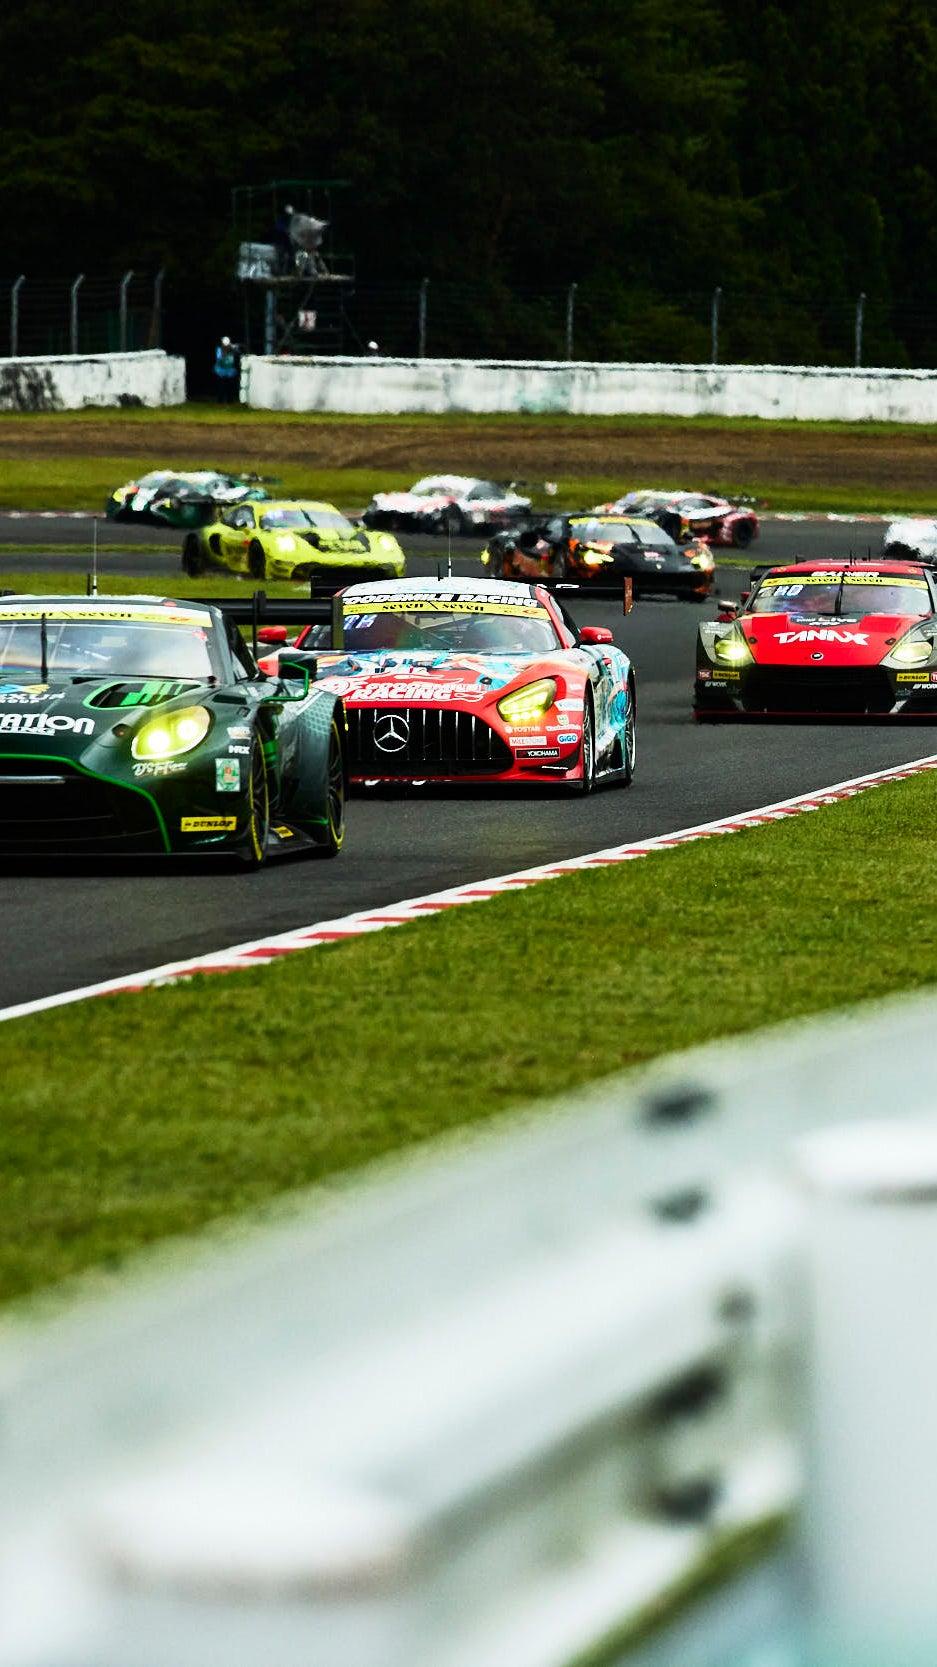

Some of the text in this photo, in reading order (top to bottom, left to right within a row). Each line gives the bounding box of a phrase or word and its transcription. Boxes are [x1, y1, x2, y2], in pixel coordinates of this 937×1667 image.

[458, 594, 538, 608] RACING
[773, 629, 870, 646] TANAX
[350, 686, 452, 700] RACING
[192, 820, 234, 828] DUNLOP
